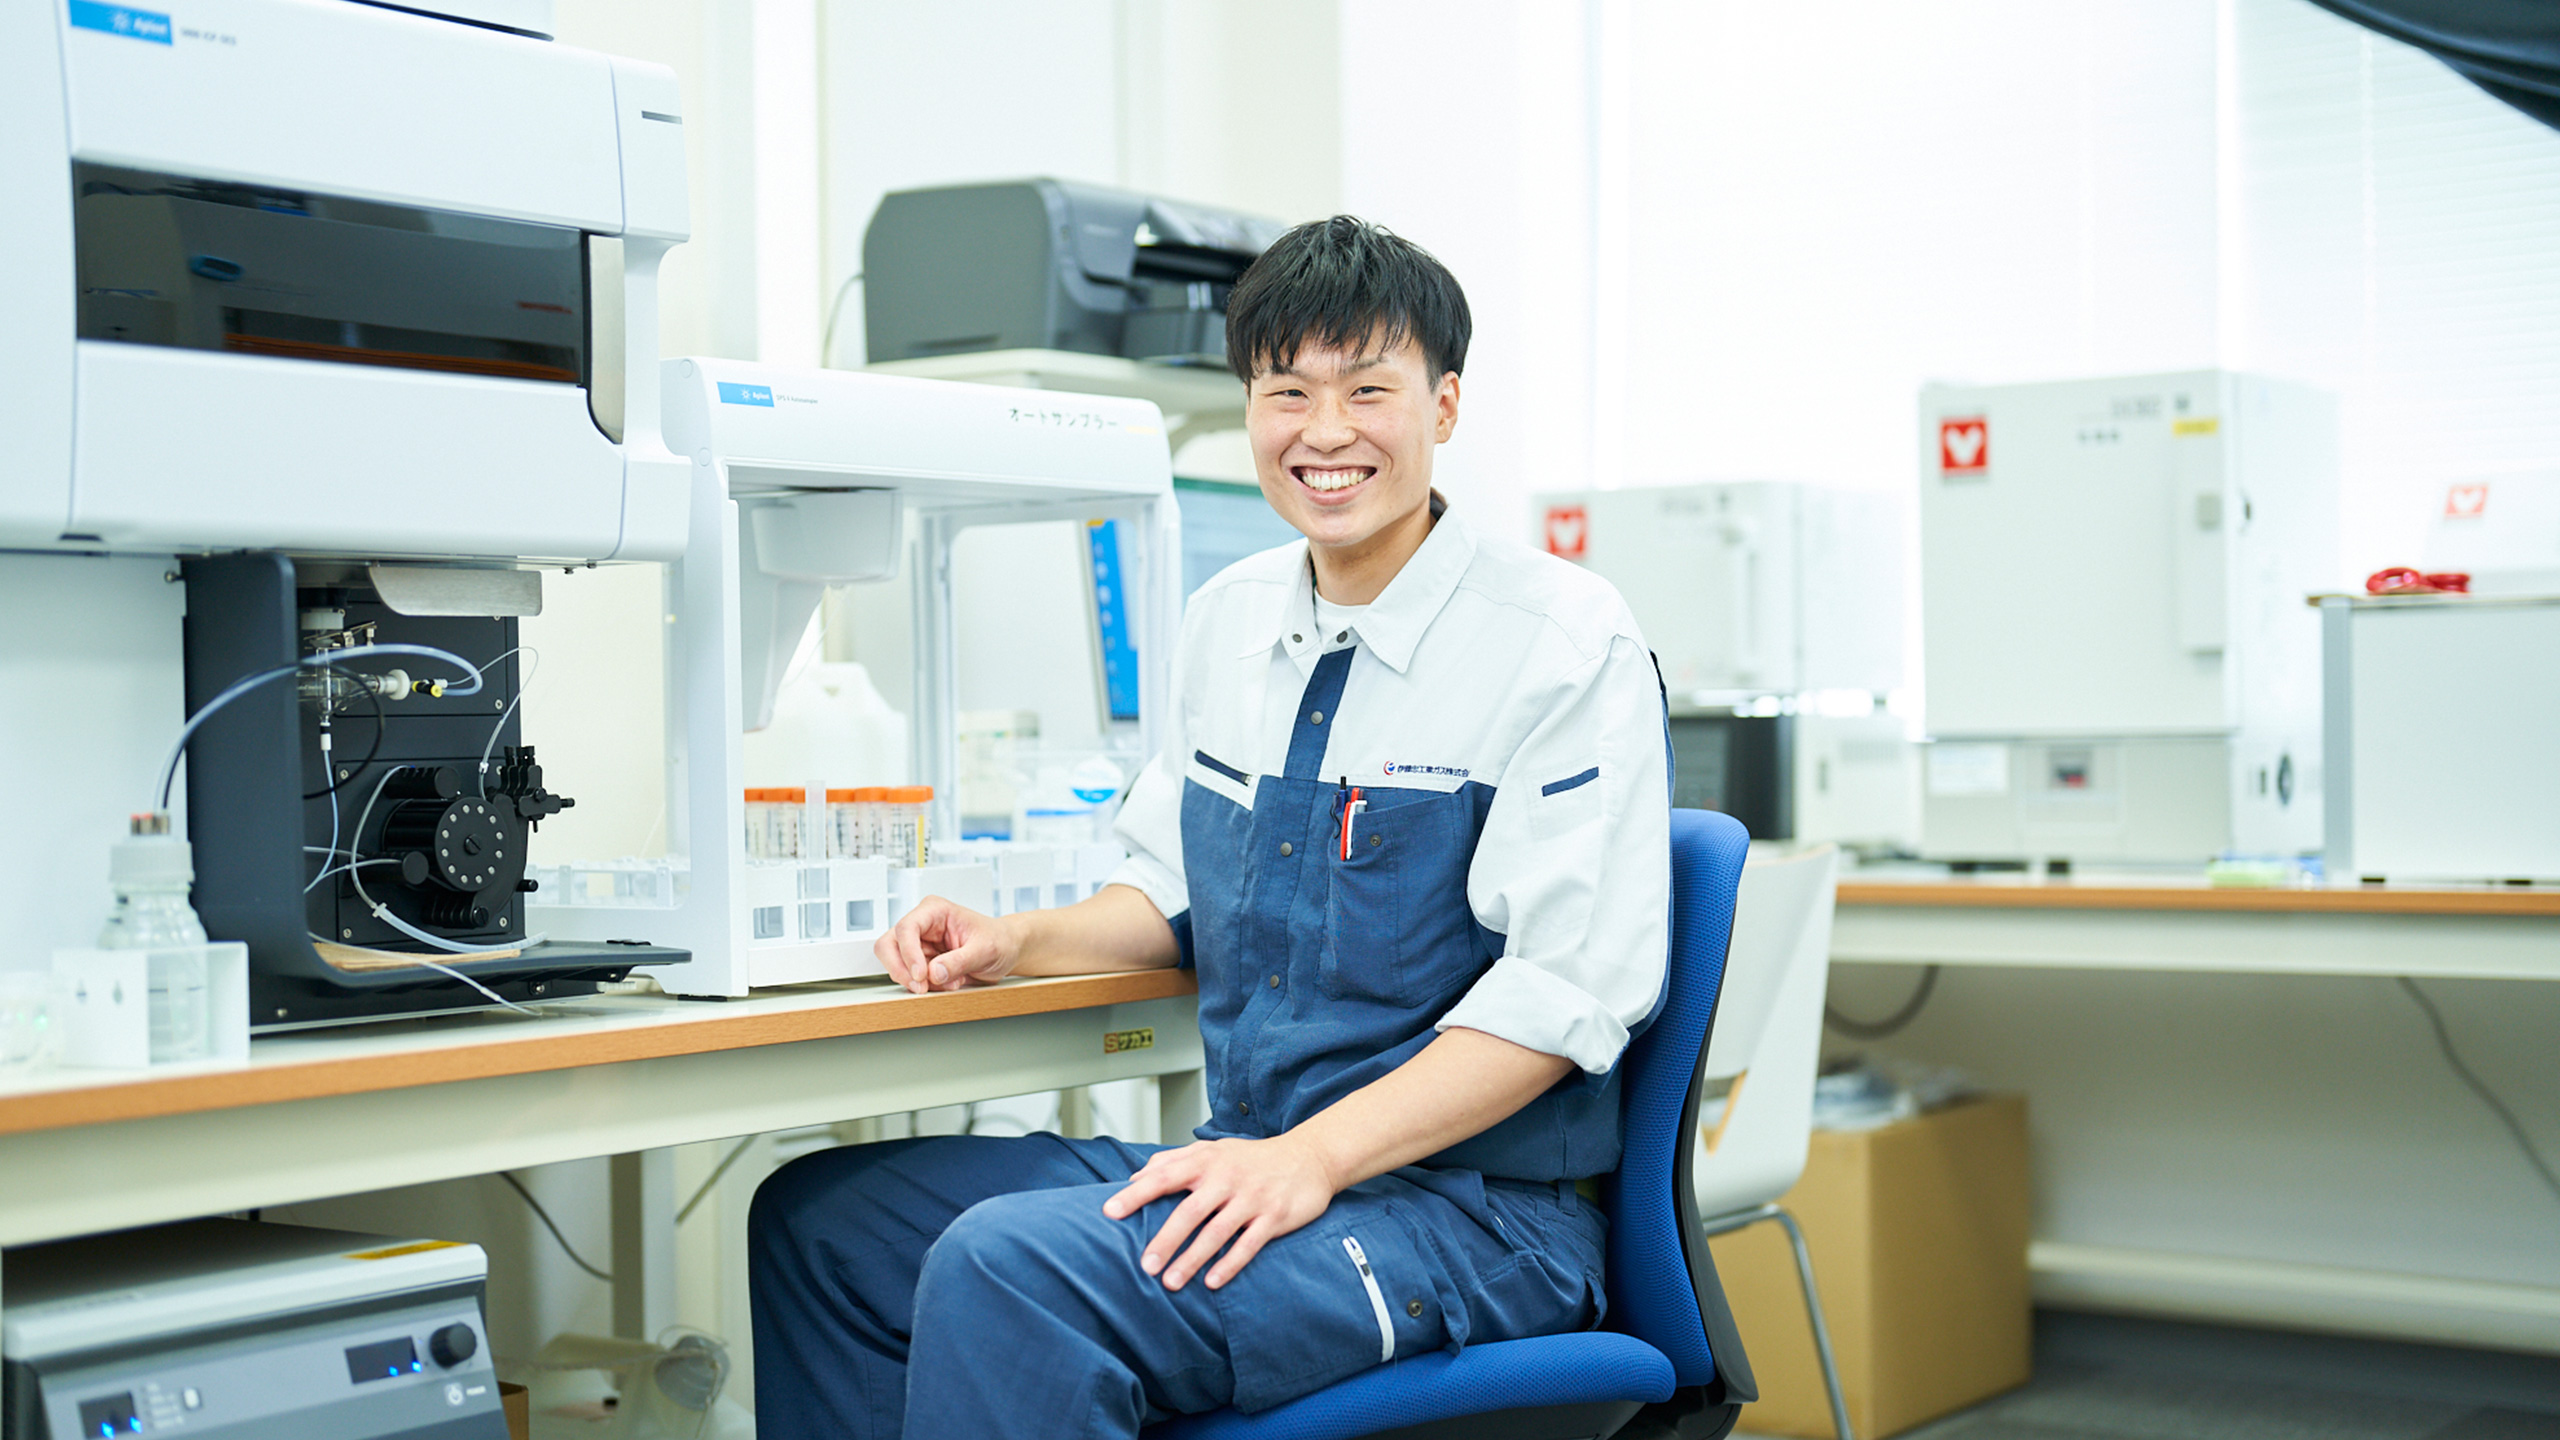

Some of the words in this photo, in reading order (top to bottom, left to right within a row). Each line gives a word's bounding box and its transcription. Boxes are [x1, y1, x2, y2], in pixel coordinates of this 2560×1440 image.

[1397, 765, 1471, 777] 伊藤忠工業ガス株式会
